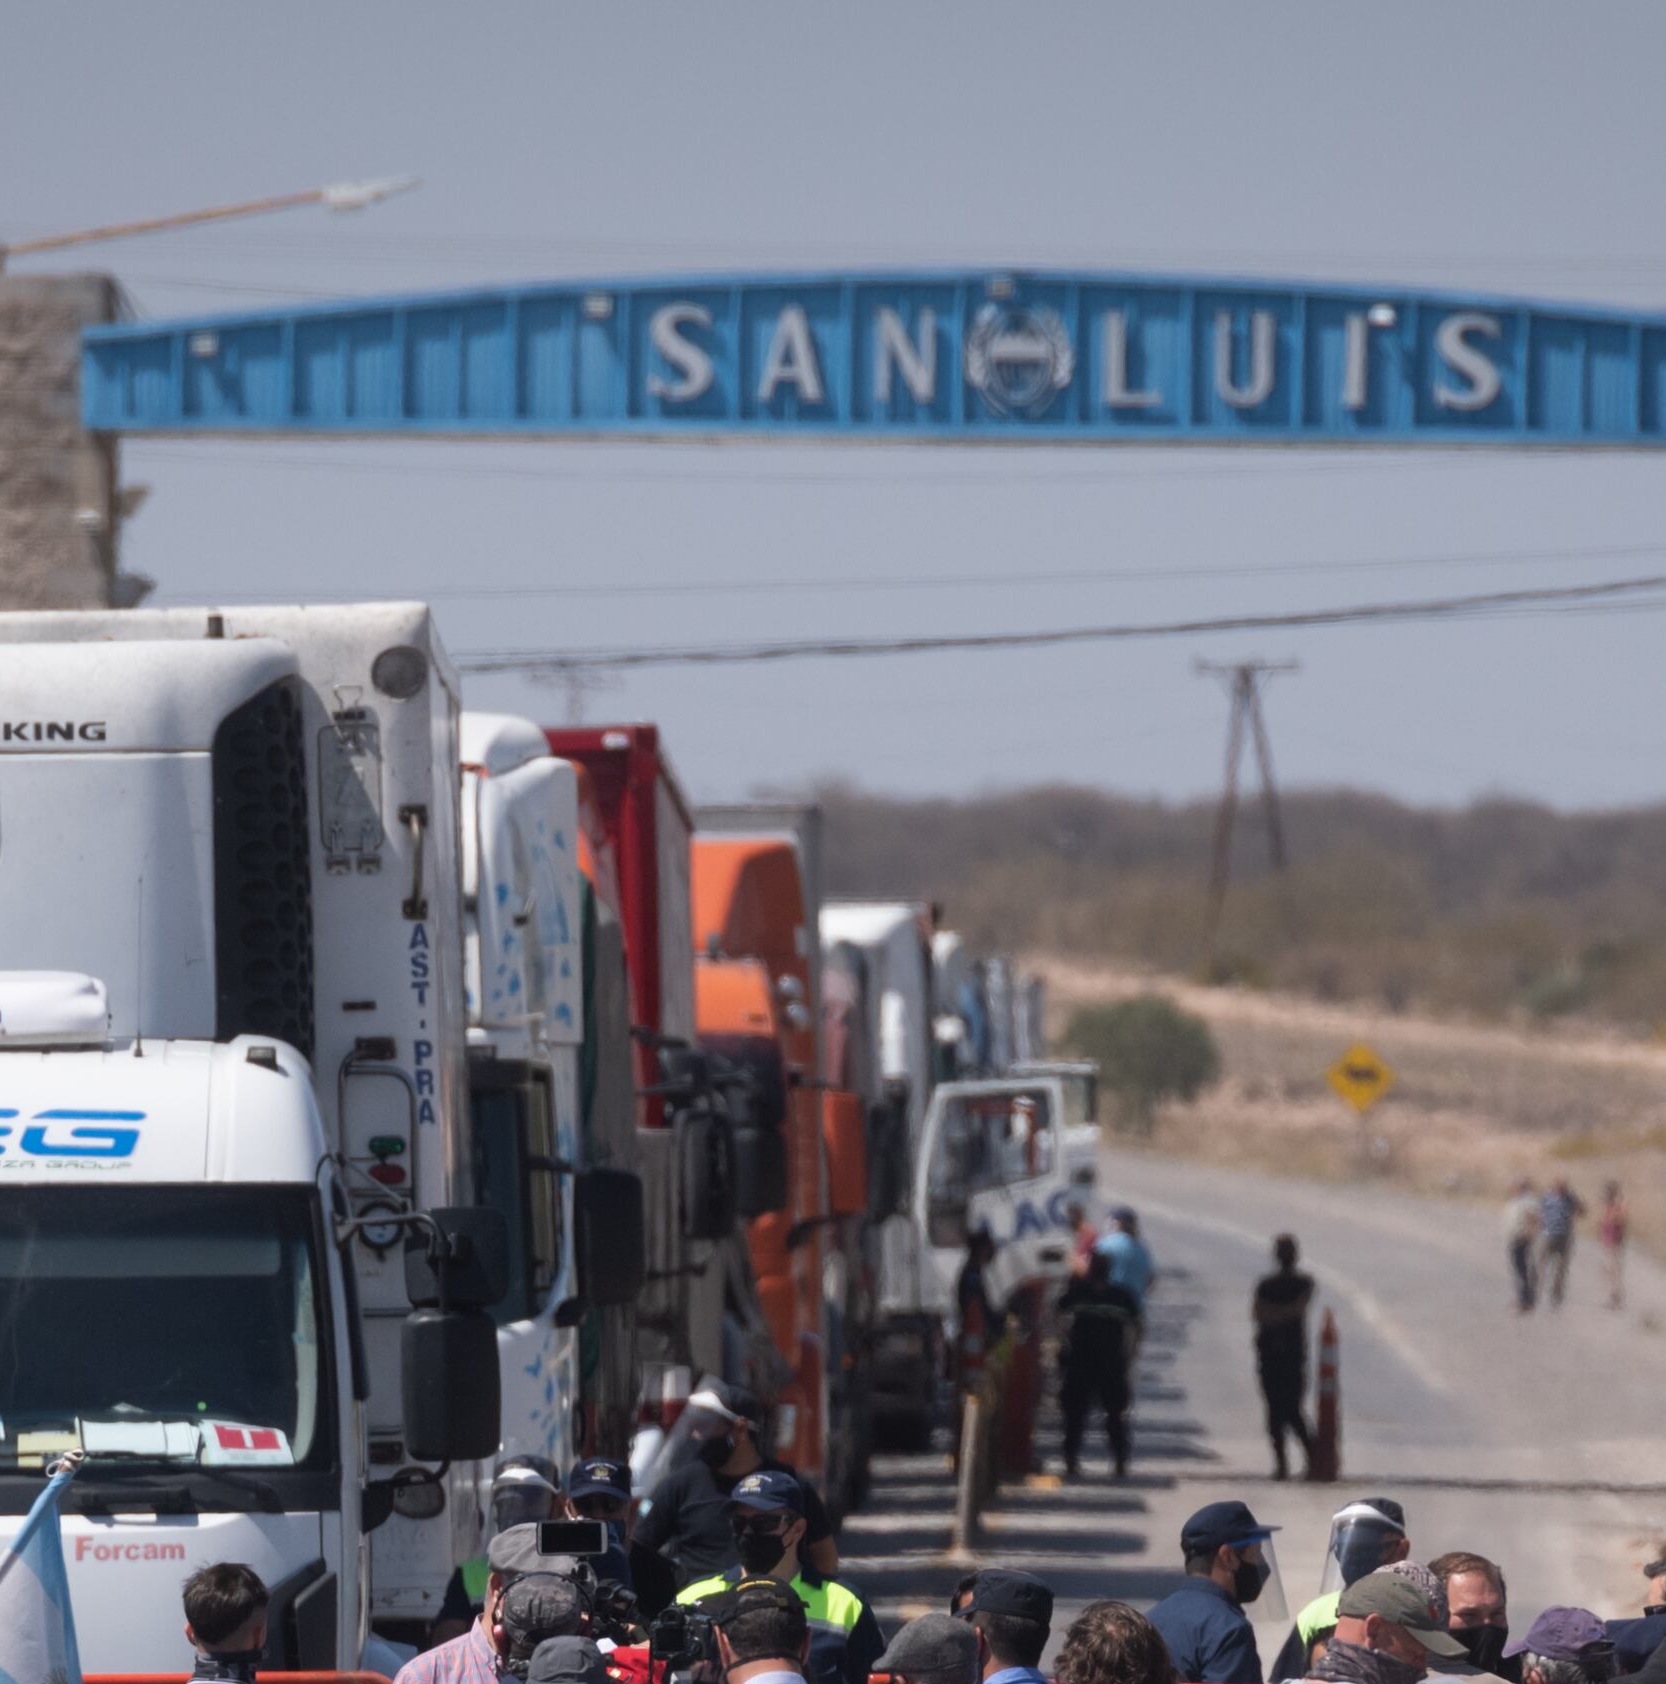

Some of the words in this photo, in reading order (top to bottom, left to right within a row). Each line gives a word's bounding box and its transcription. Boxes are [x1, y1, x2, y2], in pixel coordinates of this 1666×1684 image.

[647, 302, 937, 404] SAN
[1104, 308, 1505, 409] LUIS
[2, 721, 107, 742] KING
[75, 1535, 186, 1562] Forcam
